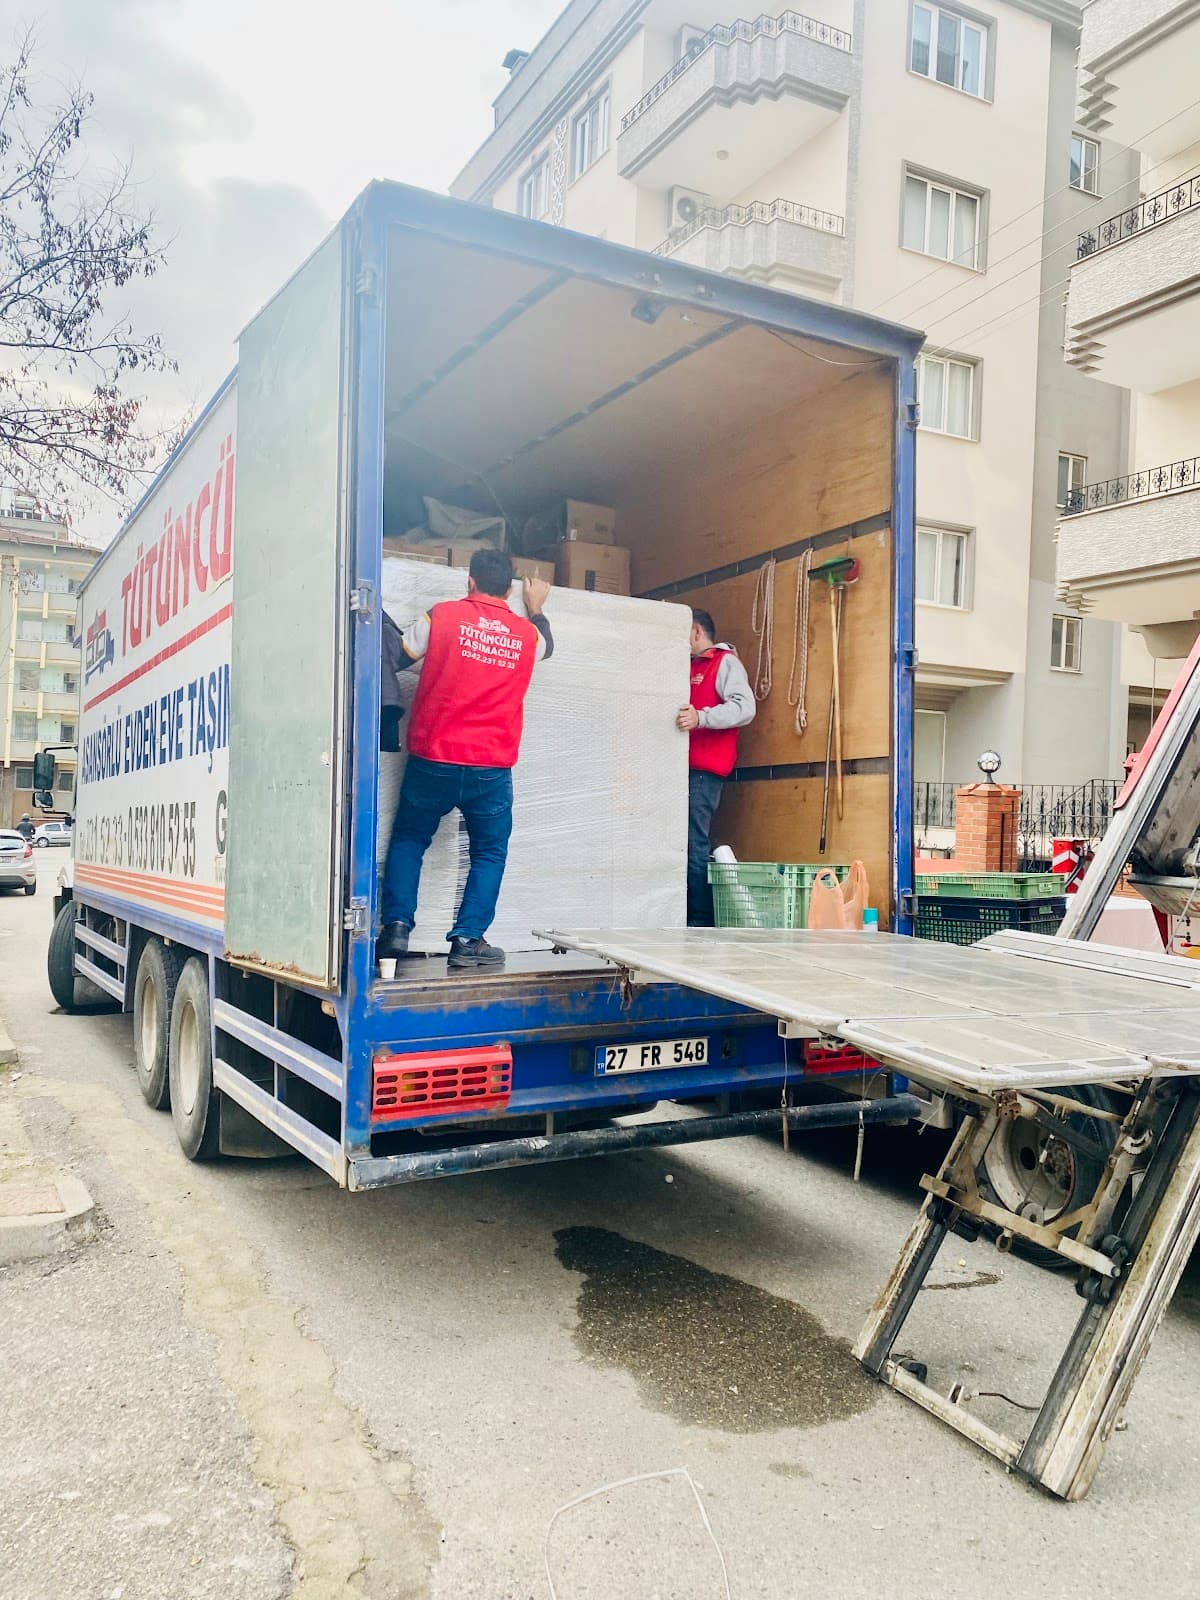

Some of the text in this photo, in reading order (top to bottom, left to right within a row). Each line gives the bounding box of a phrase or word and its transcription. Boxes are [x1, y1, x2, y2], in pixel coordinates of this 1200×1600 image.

[458, 637, 521, 661] TAŞIMACILIK
[459, 625, 523, 651] TÜTÜNCÜLER
[81, 704, 122, 784] ASANSÖRLÜ
[124, 700, 158, 774] EVDEN
[159, 686, 184, 766] EVE
[150, 803, 166, 873] 810
[183, 801, 196, 878] 55
[606, 1041, 705, 1071] 27 FR 548
